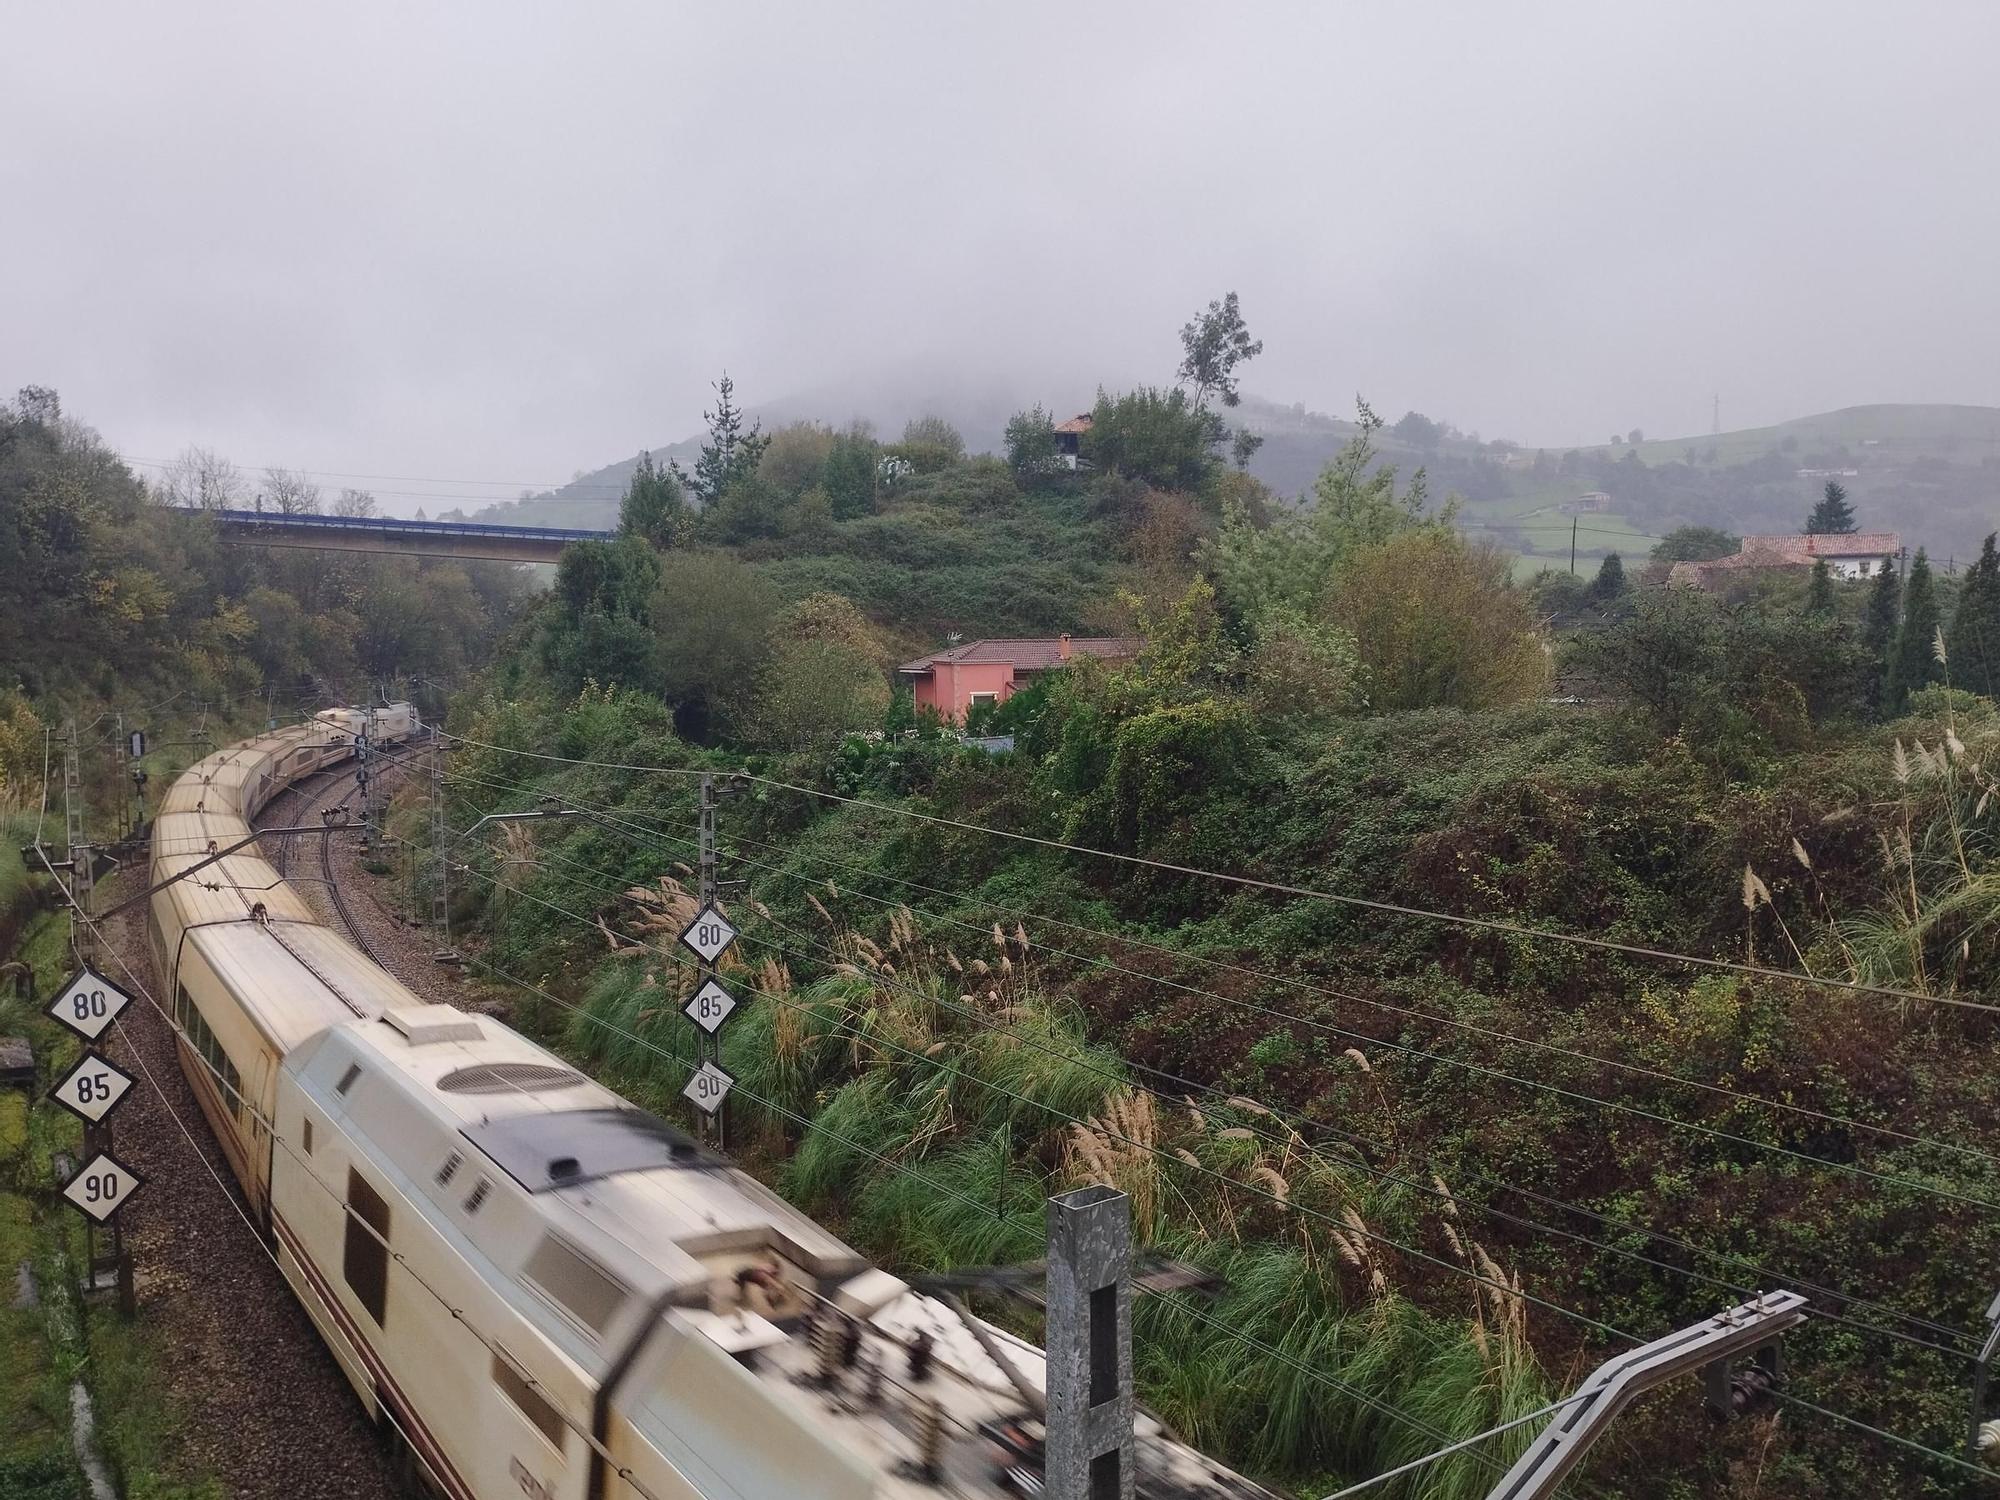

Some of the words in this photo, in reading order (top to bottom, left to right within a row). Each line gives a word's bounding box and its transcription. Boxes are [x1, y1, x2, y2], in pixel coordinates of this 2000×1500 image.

[698, 924, 721, 947] 80
[73, 989, 107, 1021] 80
[700, 995, 722, 1019] 85
[77, 1072, 111, 1104] 85
[697, 1074, 720, 1099] 90
[85, 1172, 118, 1203] 90
